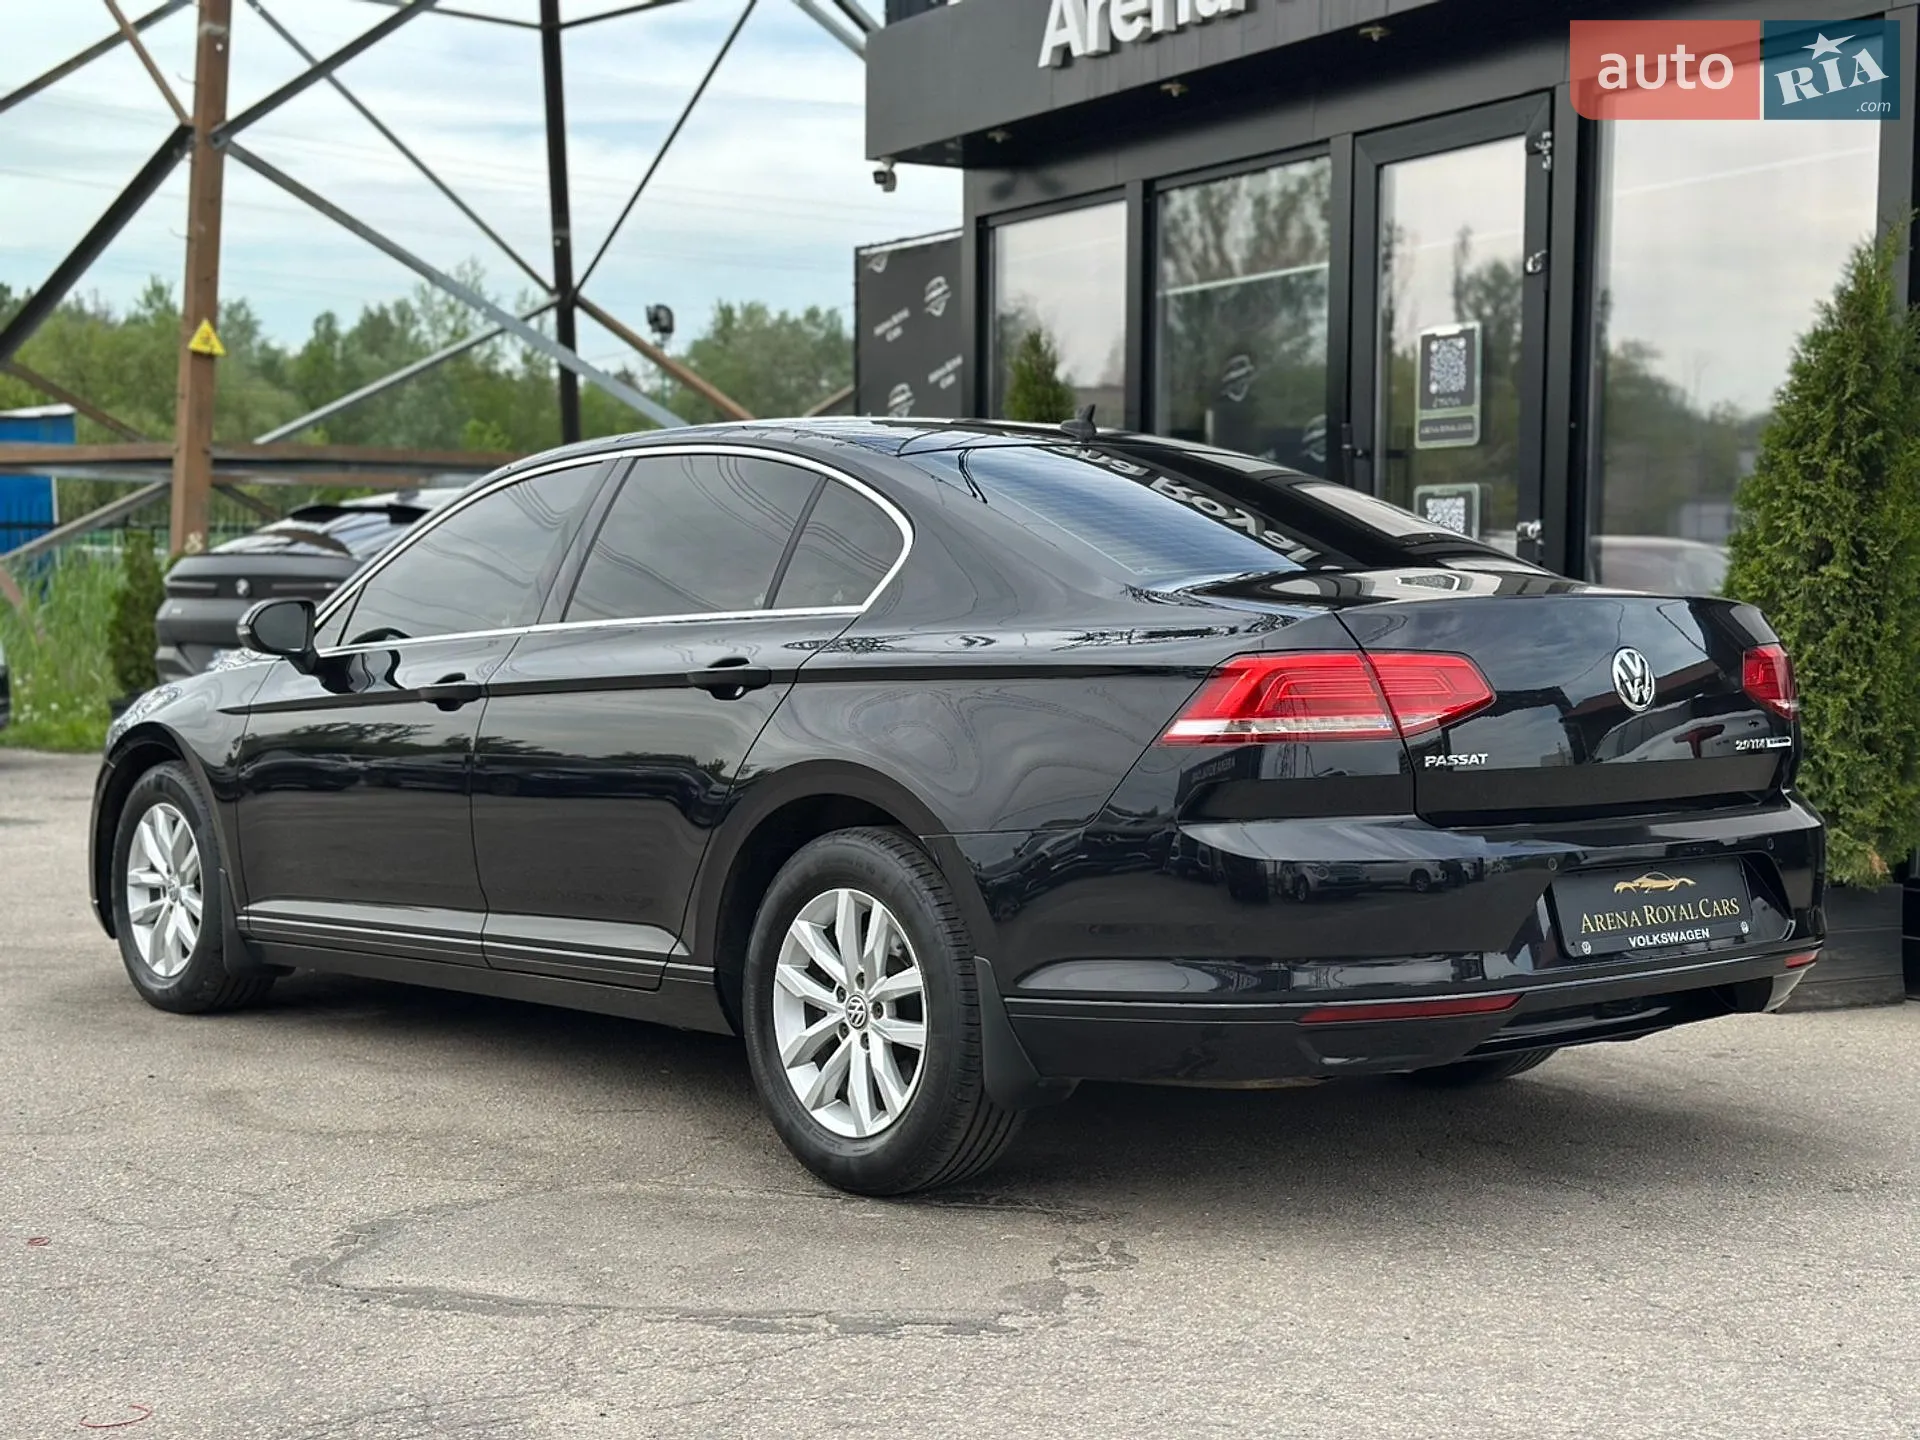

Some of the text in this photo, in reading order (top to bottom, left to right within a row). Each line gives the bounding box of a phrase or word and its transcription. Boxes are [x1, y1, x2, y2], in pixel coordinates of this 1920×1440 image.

[1424, 753, 1489, 768] PASSAT
[1581, 897, 1740, 934] ARENA ROYAL CARS
[1628, 927, 1711, 948] VOLKSWAGEN
